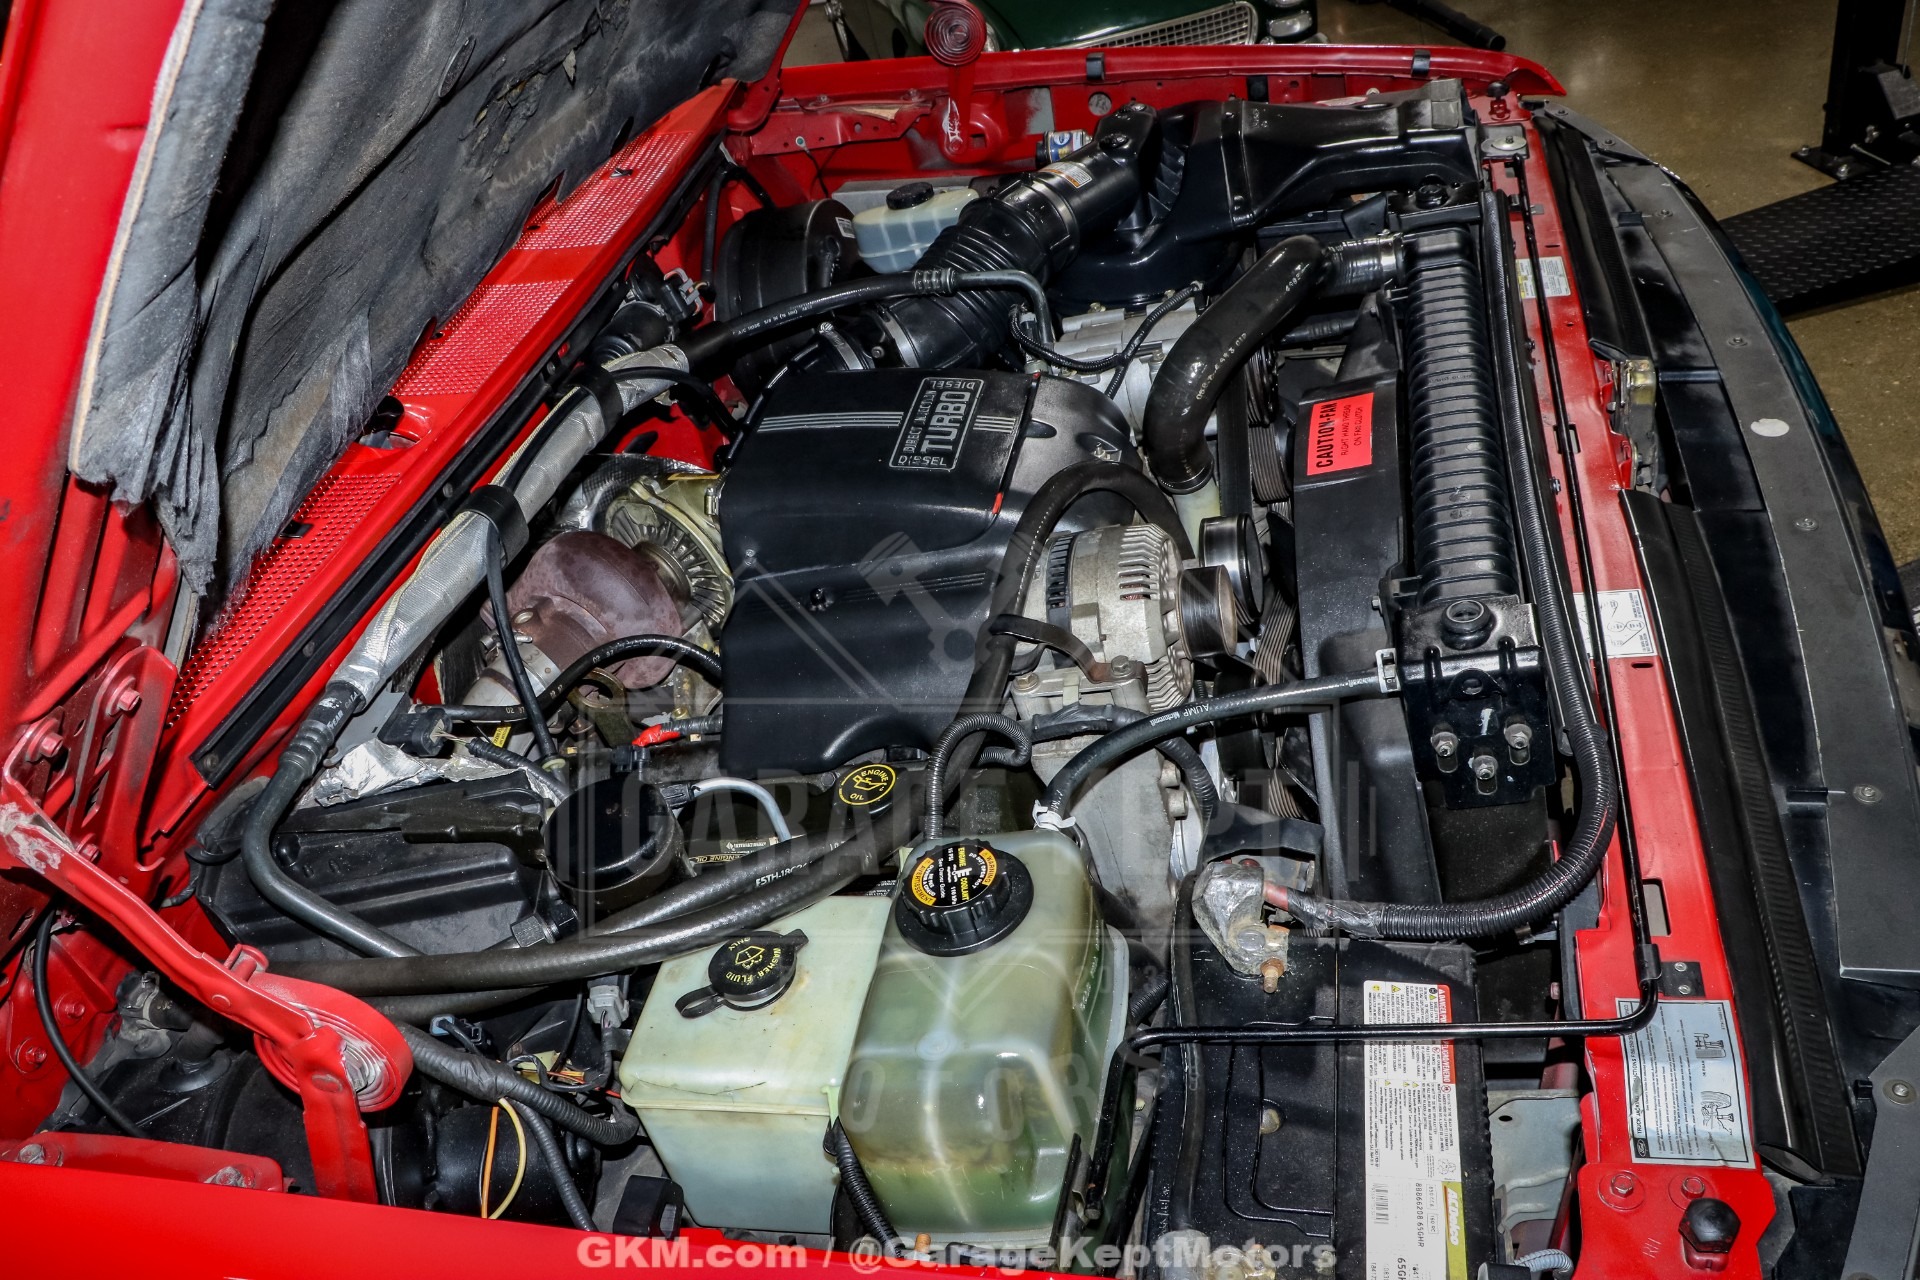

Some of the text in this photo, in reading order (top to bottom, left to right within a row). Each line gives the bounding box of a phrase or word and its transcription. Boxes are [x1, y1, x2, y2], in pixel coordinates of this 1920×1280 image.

[930, 380, 976, 390] DIESEL
[920, 391, 971, 454] TURBO
[861, 769, 888, 782] ENGINE
[914, 865, 932, 903] AVERTISSEMENT
[984, 855, 995, 883] WARNING
[726, 948, 781, 985] WASHER FLUID
[1448, 1188, 1460, 1246] ACDelco
